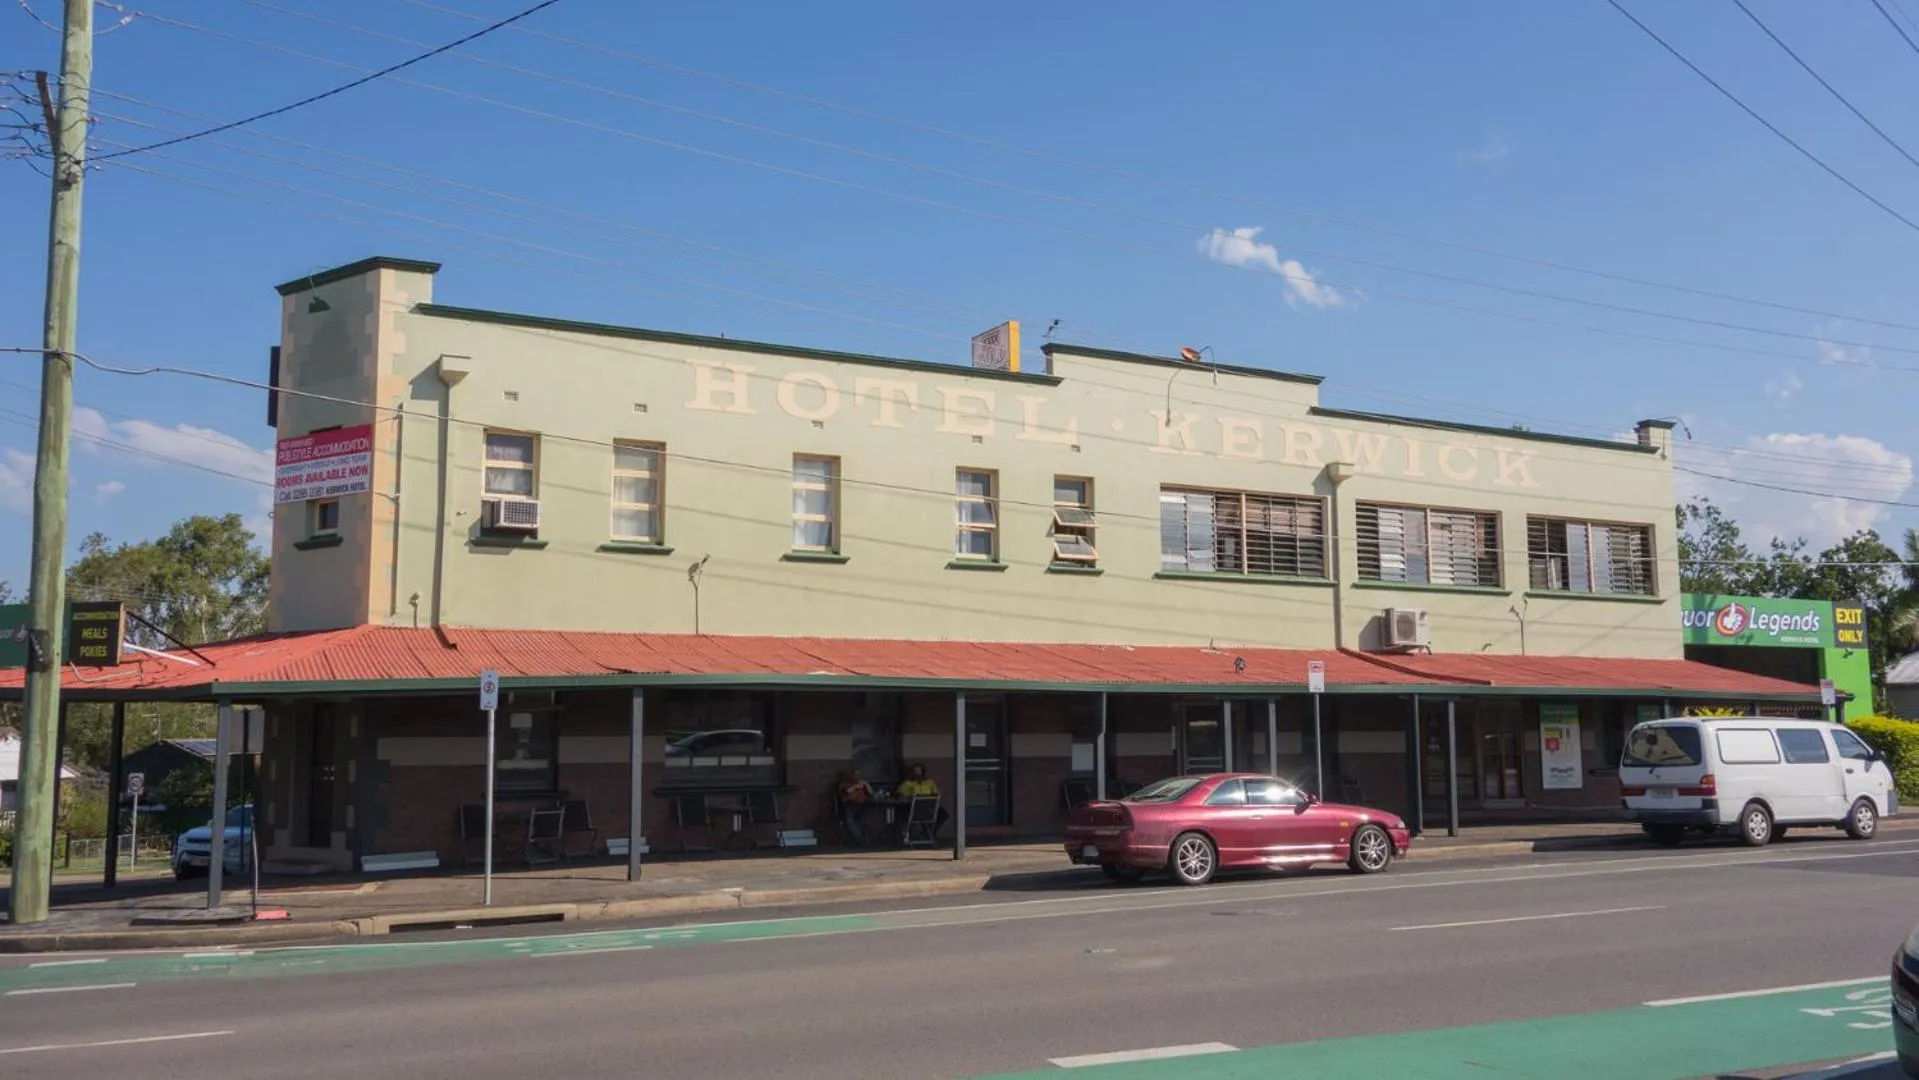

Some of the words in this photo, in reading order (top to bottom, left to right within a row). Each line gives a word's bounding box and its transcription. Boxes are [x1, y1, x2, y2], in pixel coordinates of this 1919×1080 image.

[684, 358, 1079, 446] HOTEL
[1149, 408, 1542, 488] KERWICK
[305, 467, 347, 483] AVAILABLE
[348, 465, 369, 478] NOW
[1681, 609, 1715, 627] uor
[1749, 607, 1820, 636] Legends
[1835, 608, 1863, 624] EXIT
[82, 627, 108, 640] MEALS
[1837, 629, 1864, 644] ONLY
[79, 645, 108, 657] POKIES
